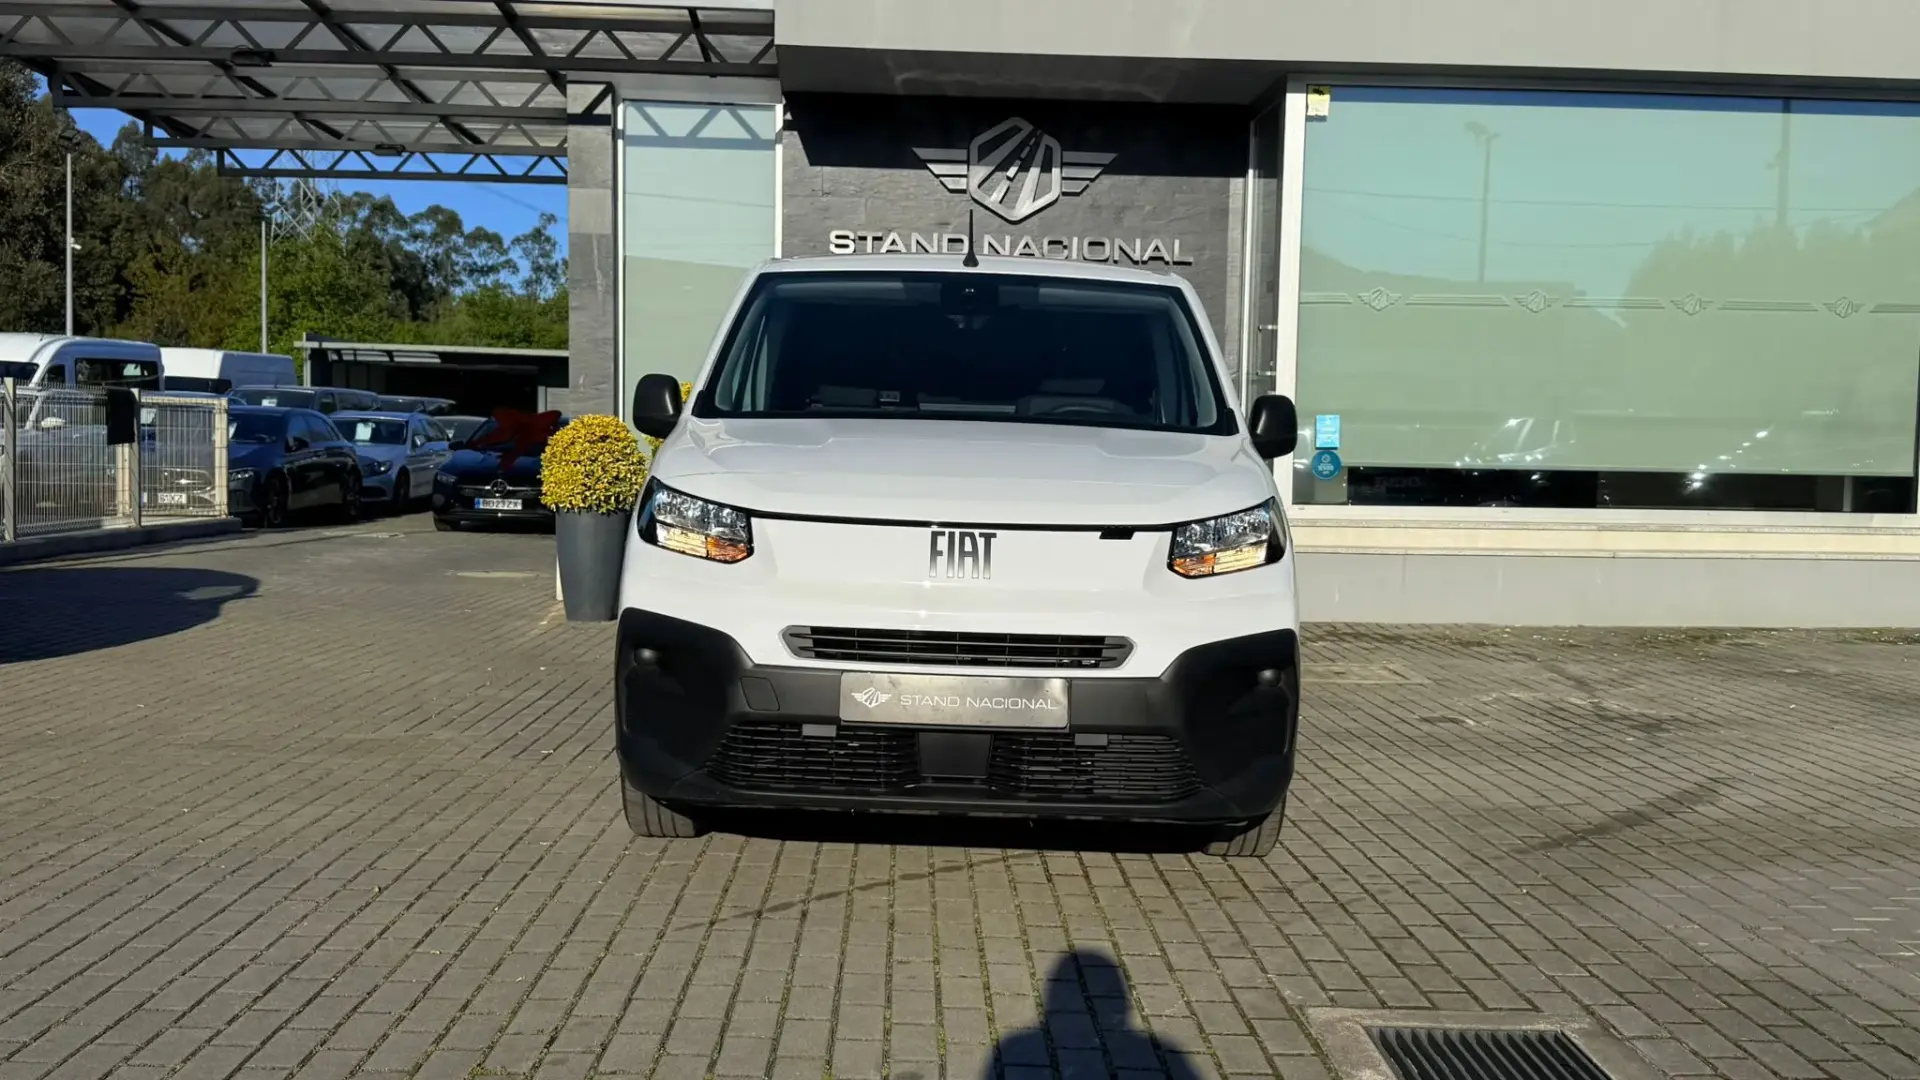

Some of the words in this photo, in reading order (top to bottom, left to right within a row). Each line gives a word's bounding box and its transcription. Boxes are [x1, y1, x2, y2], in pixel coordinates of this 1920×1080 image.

[829, 229, 969, 254] STAND
[983, 233, 1194, 266] NACIONAL
[929, 530, 997, 579] FIAT
[900, 693, 960, 708] STAND
[966, 696, 1059, 710] NACIONAL
